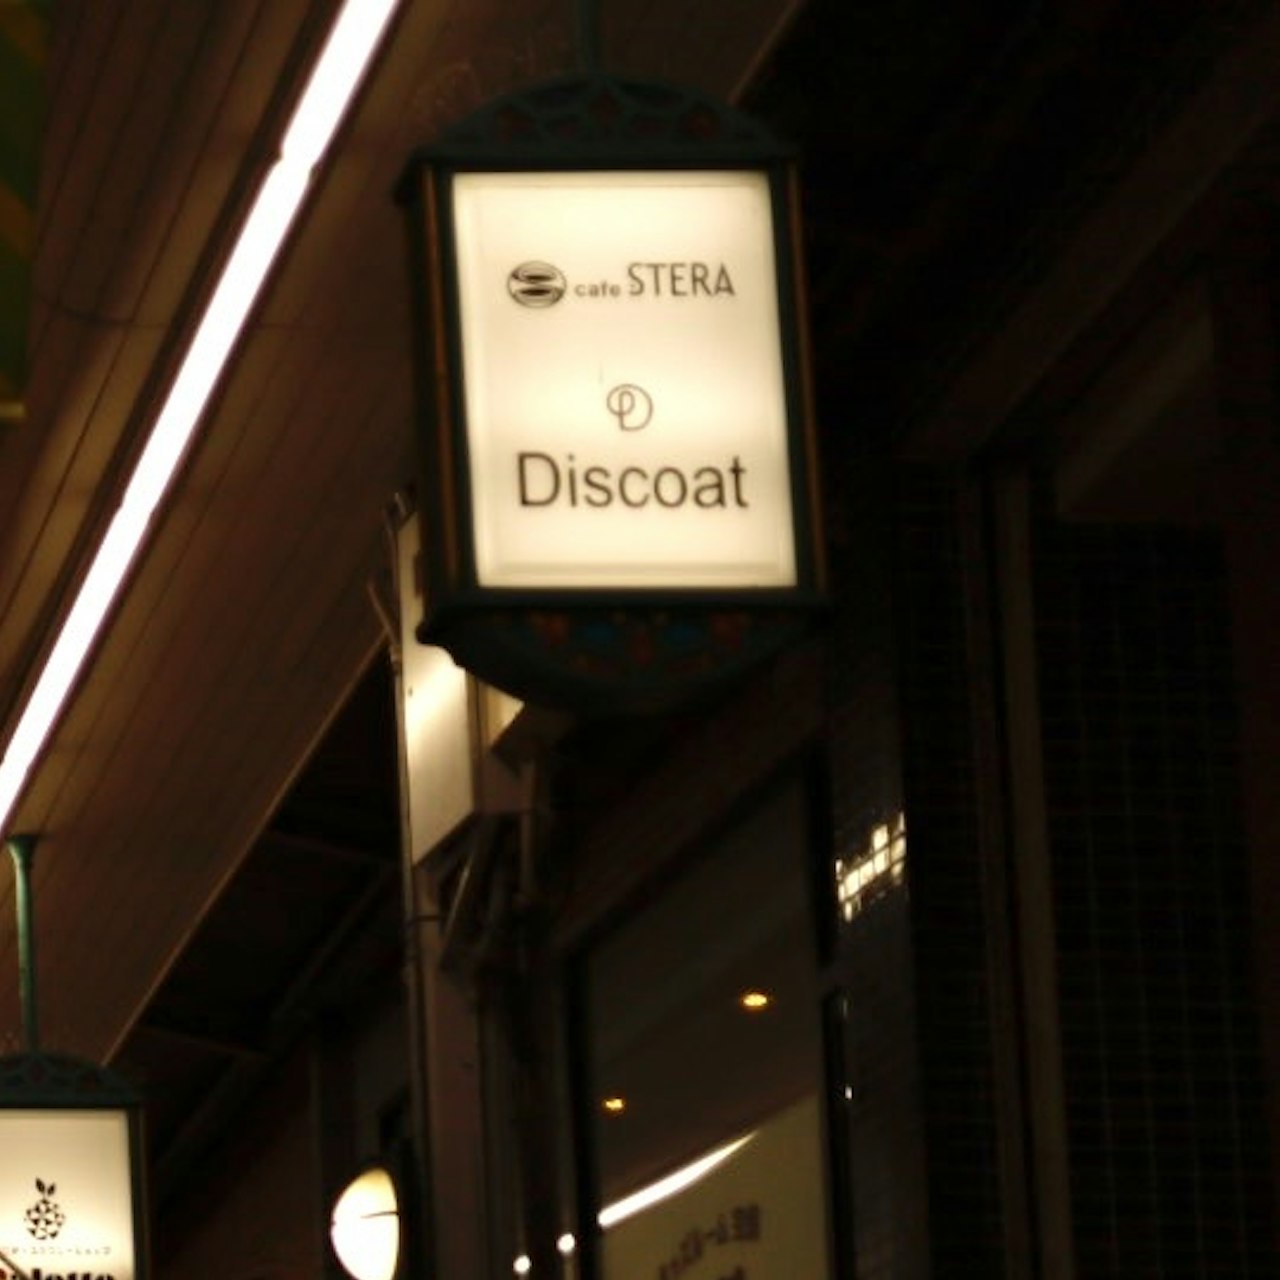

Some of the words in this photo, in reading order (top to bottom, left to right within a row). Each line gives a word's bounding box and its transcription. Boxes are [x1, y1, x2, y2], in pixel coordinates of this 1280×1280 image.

[574, 281, 622, 297] cafe
[627, 262, 736, 297] STERA
[517, 451, 750, 509] Discoat
